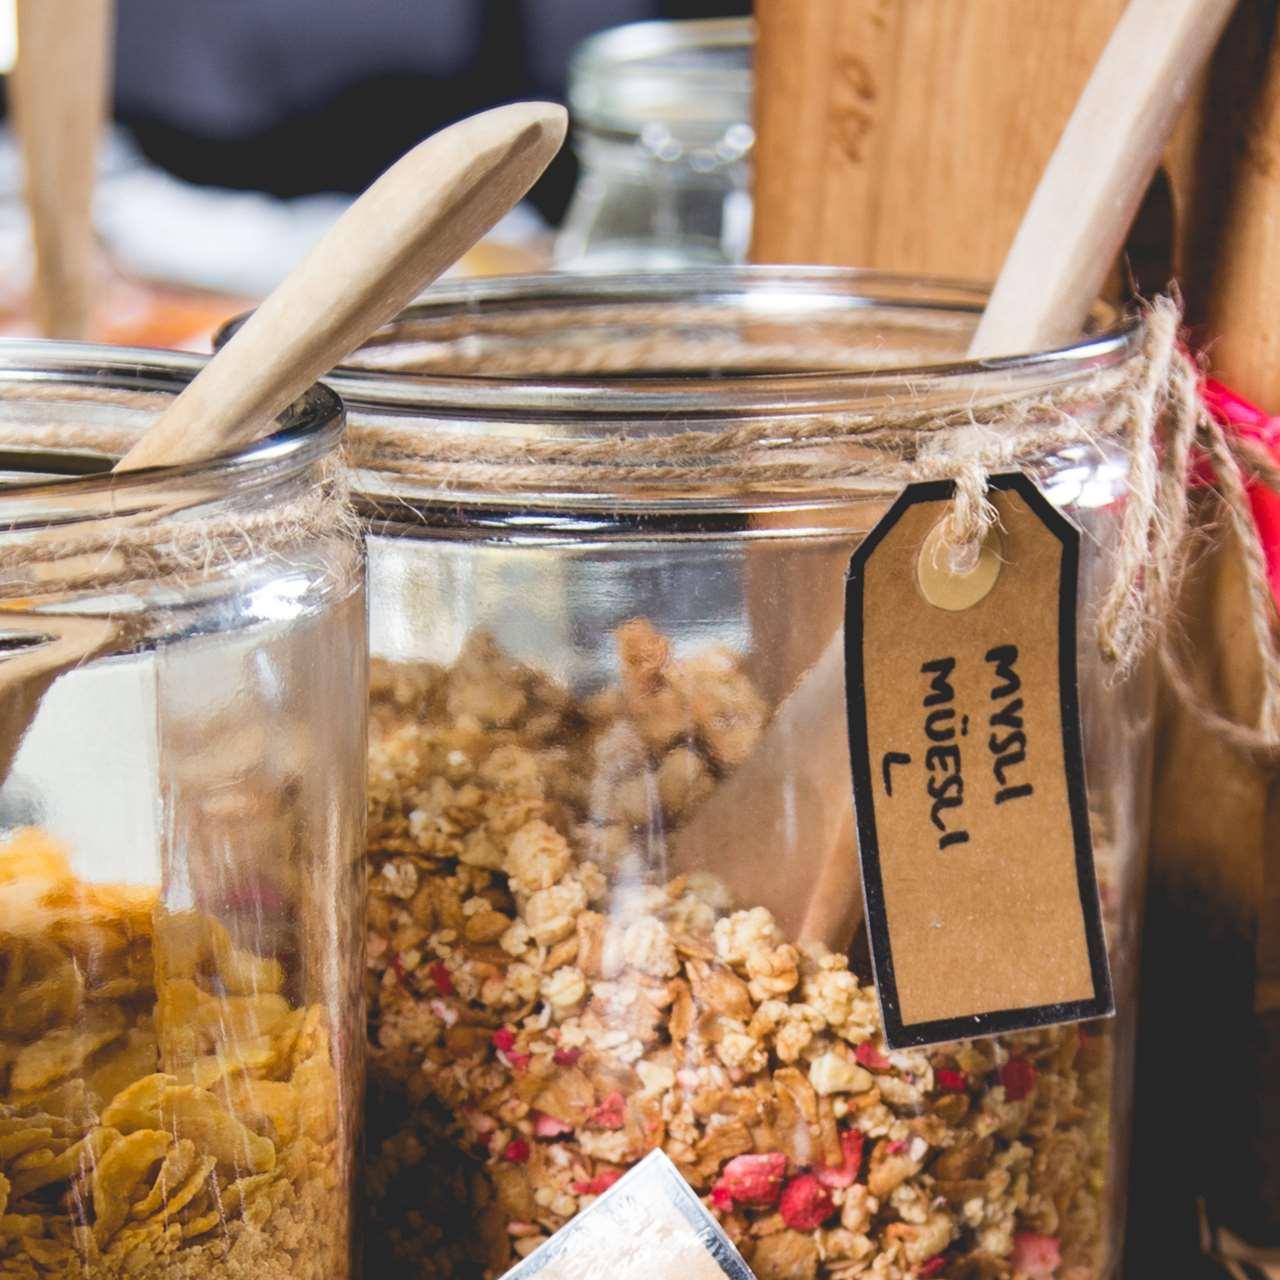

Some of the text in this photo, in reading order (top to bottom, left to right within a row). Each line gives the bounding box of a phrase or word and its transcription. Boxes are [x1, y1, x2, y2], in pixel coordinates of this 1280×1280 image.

[882, 751, 912, 798] L
[920, 656, 971, 851] MÜESLI
[984, 643, 1034, 806] MYSLI
